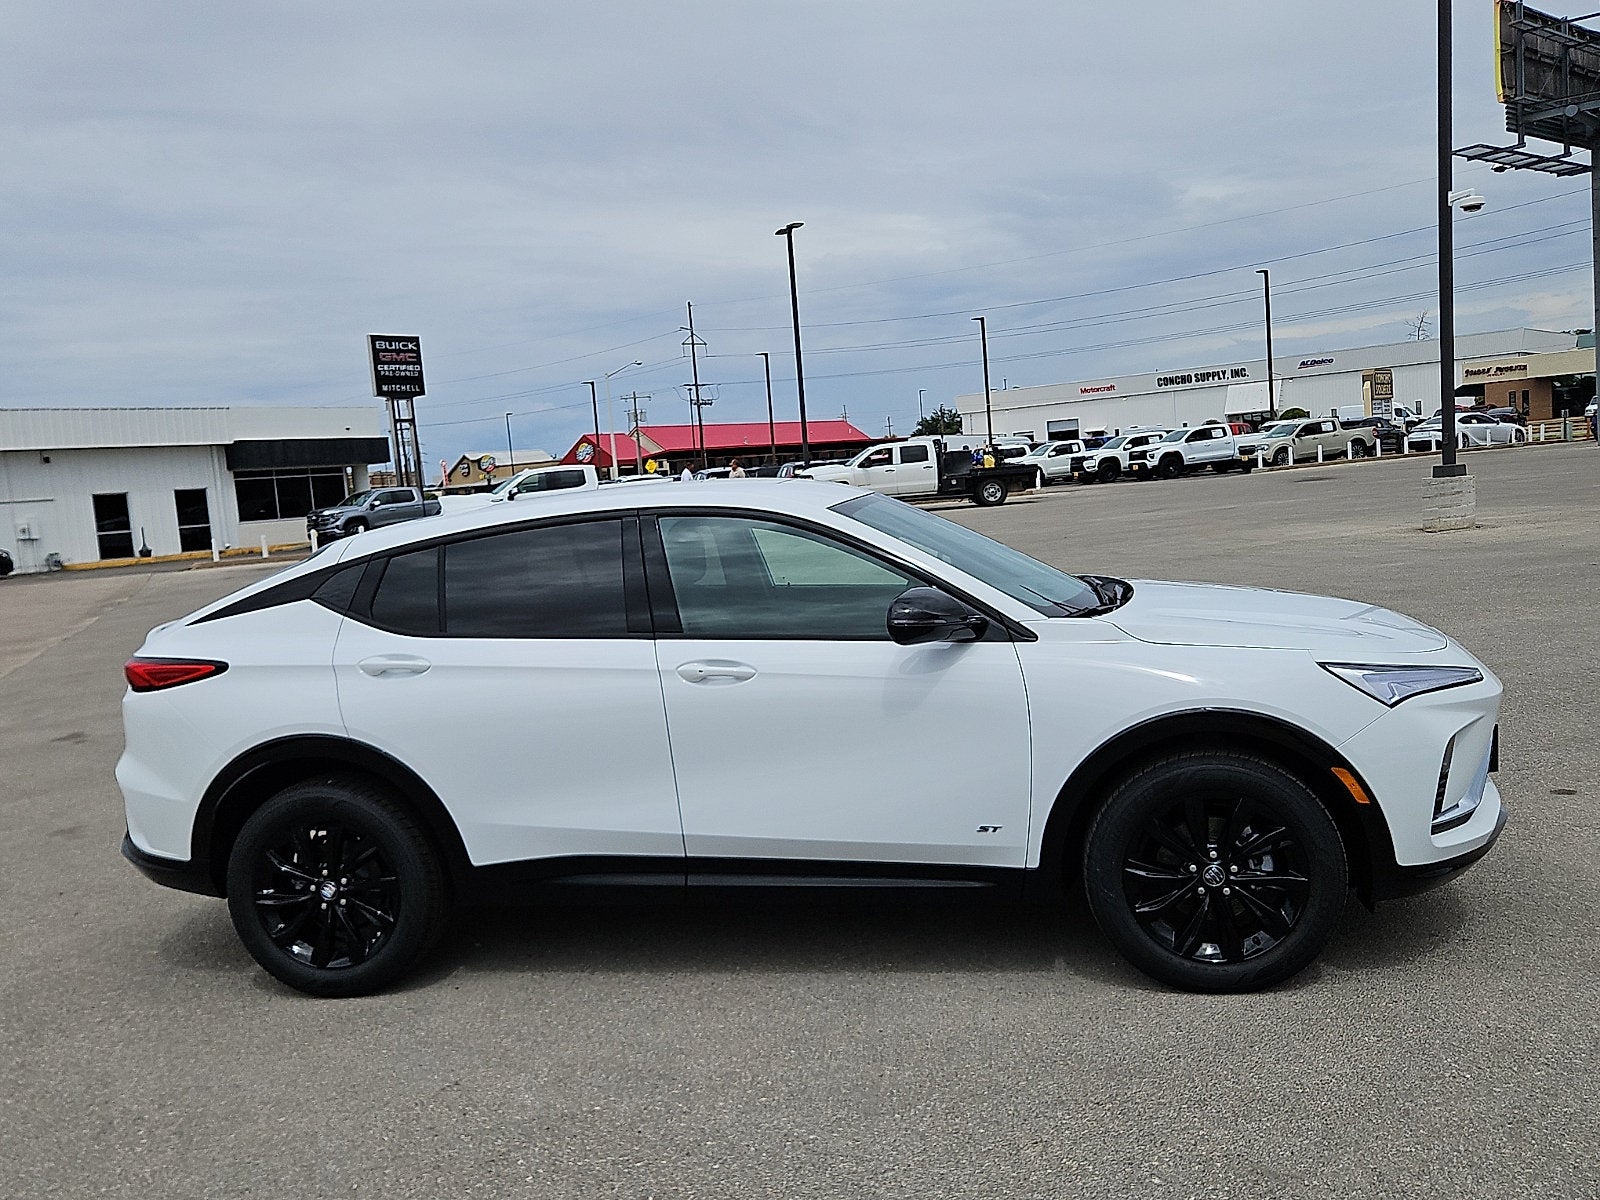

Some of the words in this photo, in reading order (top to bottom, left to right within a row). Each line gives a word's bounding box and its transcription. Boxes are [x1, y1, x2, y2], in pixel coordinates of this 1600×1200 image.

[375, 341, 417, 350] BUICK
[379, 352, 417, 361] GMC
[1299, 358, 1334, 367] ACDelco
[1157, 373, 1193, 388] CONCHO
[1194, 369, 1229, 383] SUPPLY,
[1230, 367, 1250, 379] INC.
[1080, 384, 1116, 394] Motorcraft
[976, 824, 1003, 833] ST
